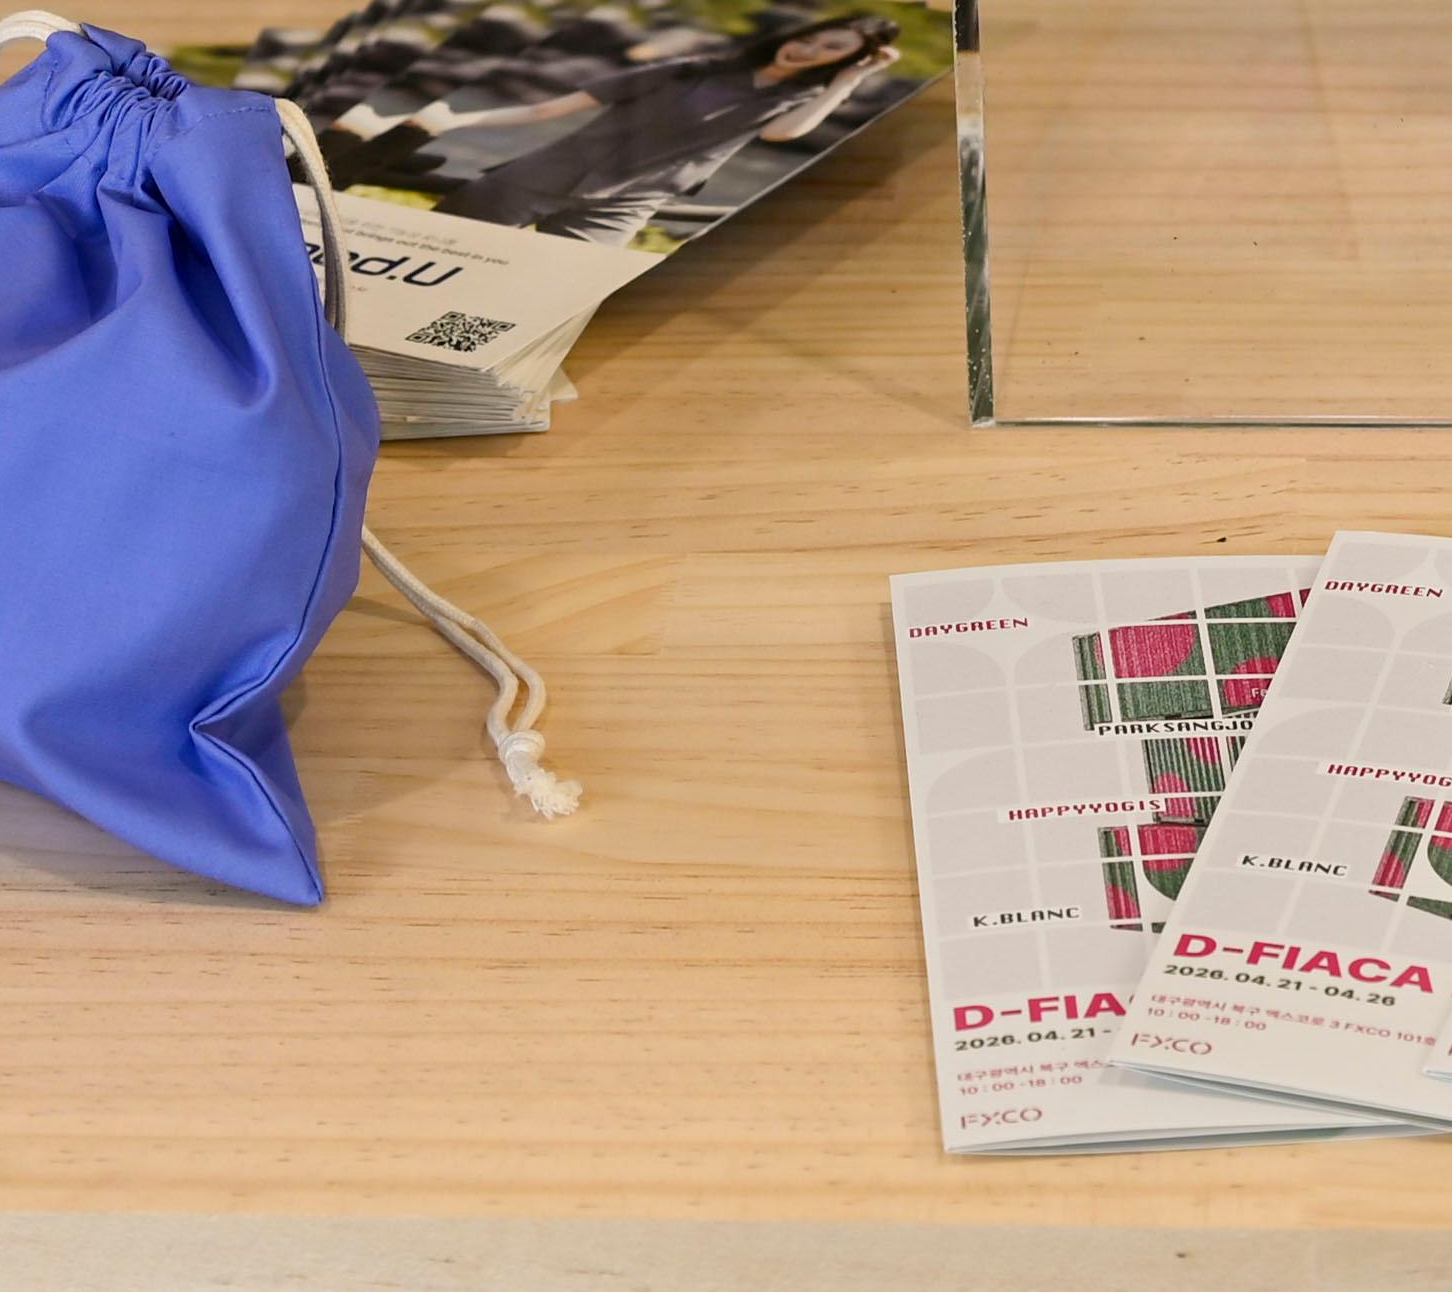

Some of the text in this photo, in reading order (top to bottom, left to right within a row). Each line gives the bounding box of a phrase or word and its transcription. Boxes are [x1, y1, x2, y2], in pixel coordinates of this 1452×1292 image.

[1324, 580, 1443, 598] DAYGREEN
[909, 618, 1029, 639] DAYGREEN
[1008, 799, 1161, 821] HAPPYYOGIS
[1241, 854, 1348, 877] K.BLANC
[973, 906, 1080, 928] K.BLANC
[1172, 933, 1434, 994] D-FIACA
